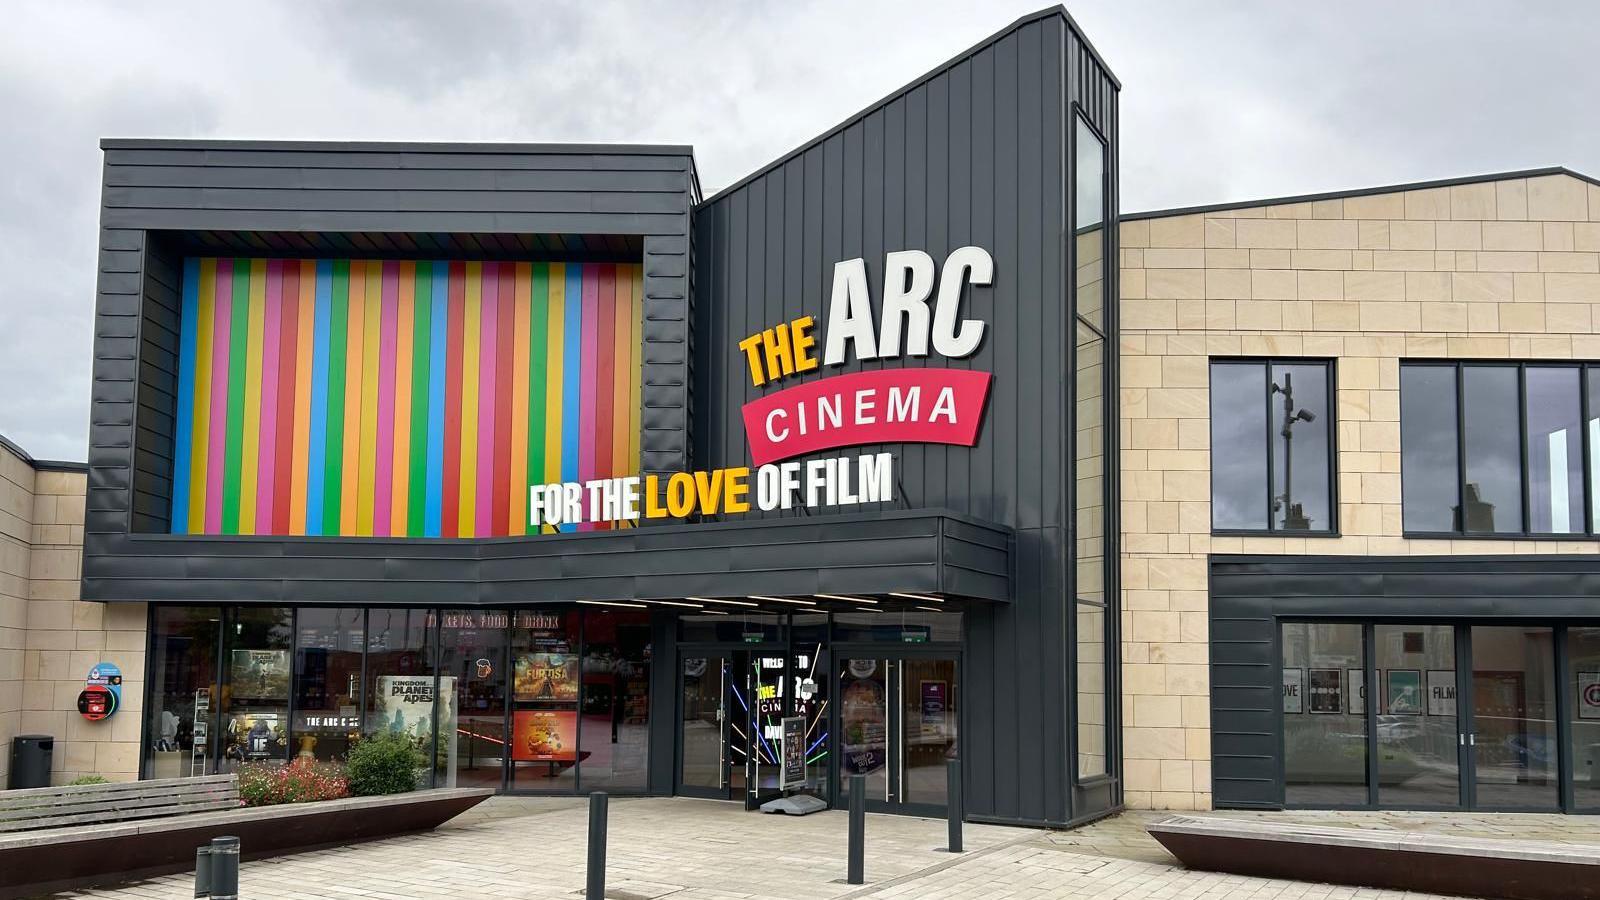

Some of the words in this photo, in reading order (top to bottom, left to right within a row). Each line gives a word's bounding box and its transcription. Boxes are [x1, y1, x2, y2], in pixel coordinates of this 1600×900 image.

[738, 315, 819, 387] THE
[823, 246, 994, 366] ARC
[765, 386, 958, 443] CINEMA
[530, 482, 583, 526] FOR
[586, 476, 640, 522] THE
[645, 466, 749, 519] LOVE
[757, 461, 801, 512] OF
[805, 452, 893, 507] FILM
[526, 668, 568, 680] FUROSA
[391, 686, 433, 697] PLANET
[1433, 686, 1455, 699] FILM
[403, 694, 433, 705] APES
[761, 702, 806, 714] CINA
[306, 717, 321, 727] THE
[323, 717, 338, 727] ARC
[253, 738, 268, 752] IF
